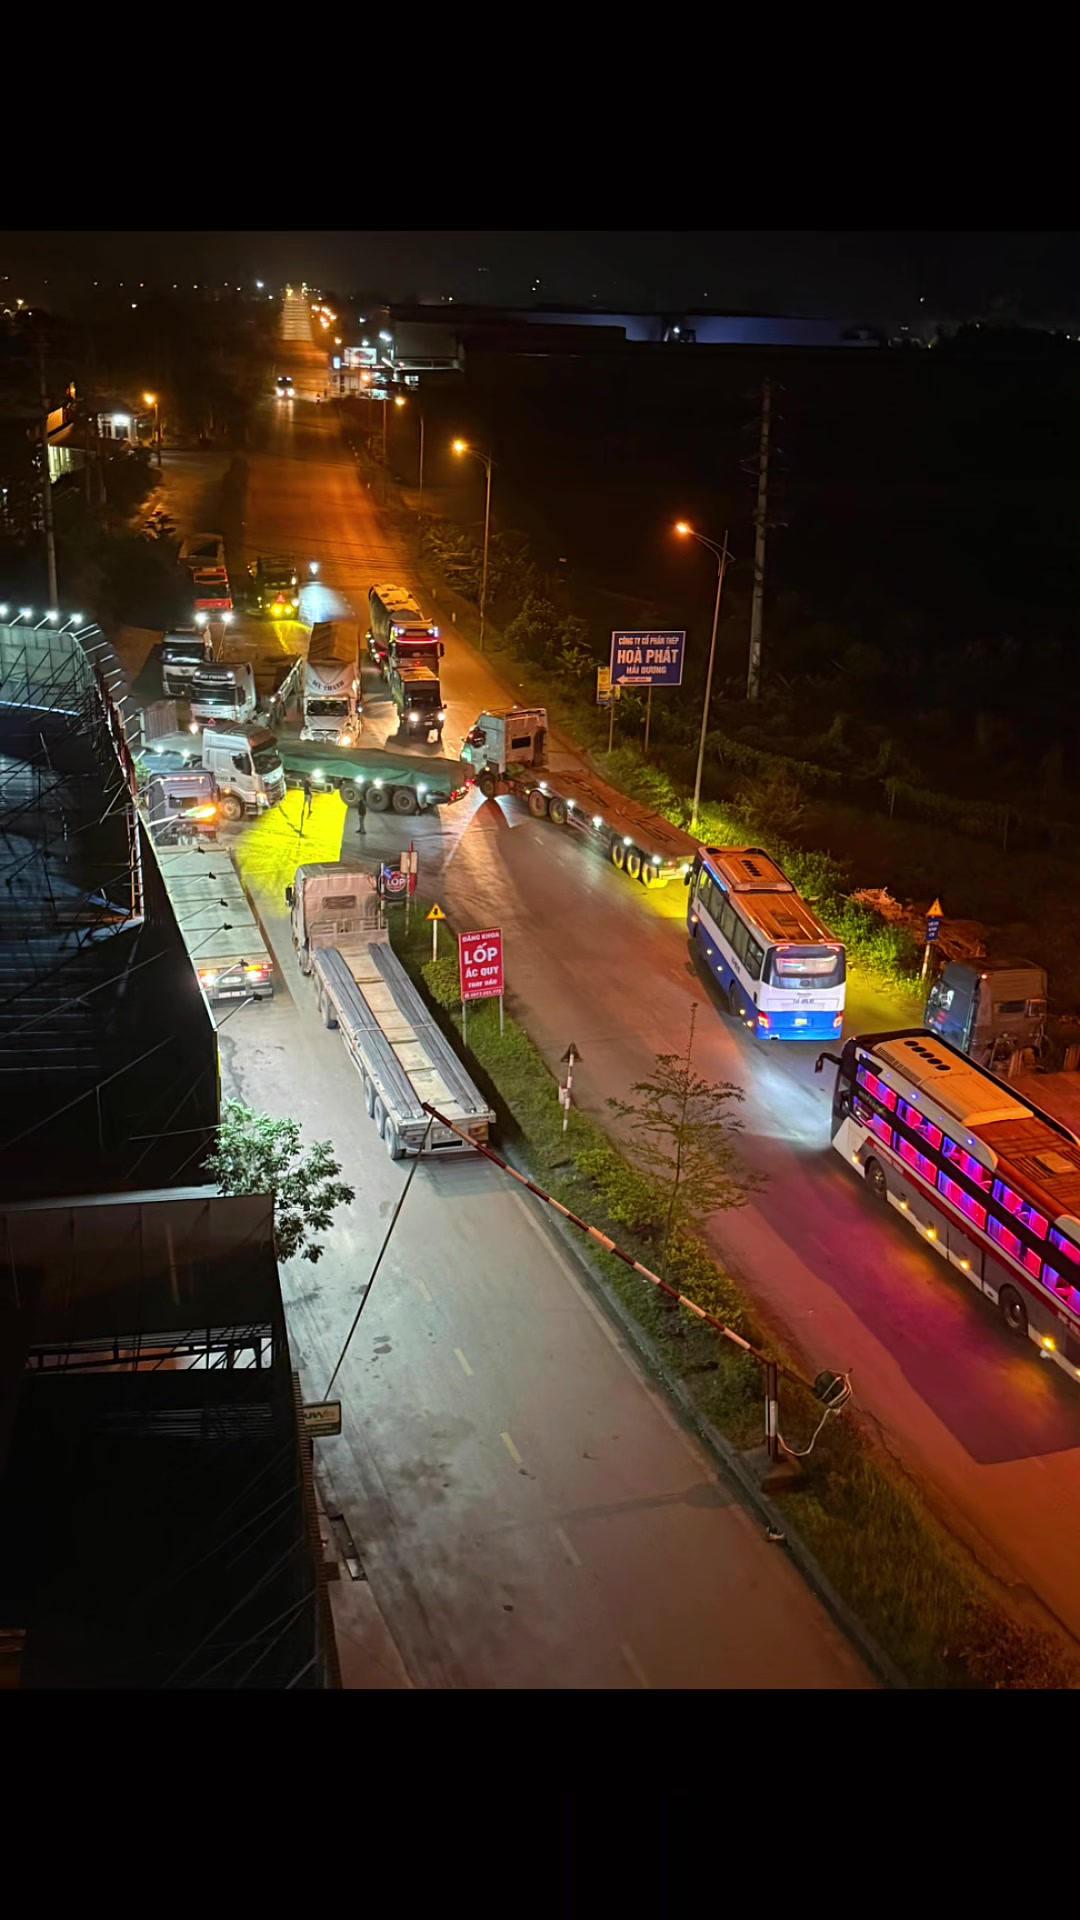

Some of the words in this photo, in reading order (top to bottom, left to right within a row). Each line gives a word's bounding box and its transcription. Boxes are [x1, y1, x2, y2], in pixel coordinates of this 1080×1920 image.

[617, 646, 642, 664] HOÀ
[646, 646, 679, 664] PHÁT
[464, 942, 498, 964] LỐP
[480, 966, 499, 976] QUY
